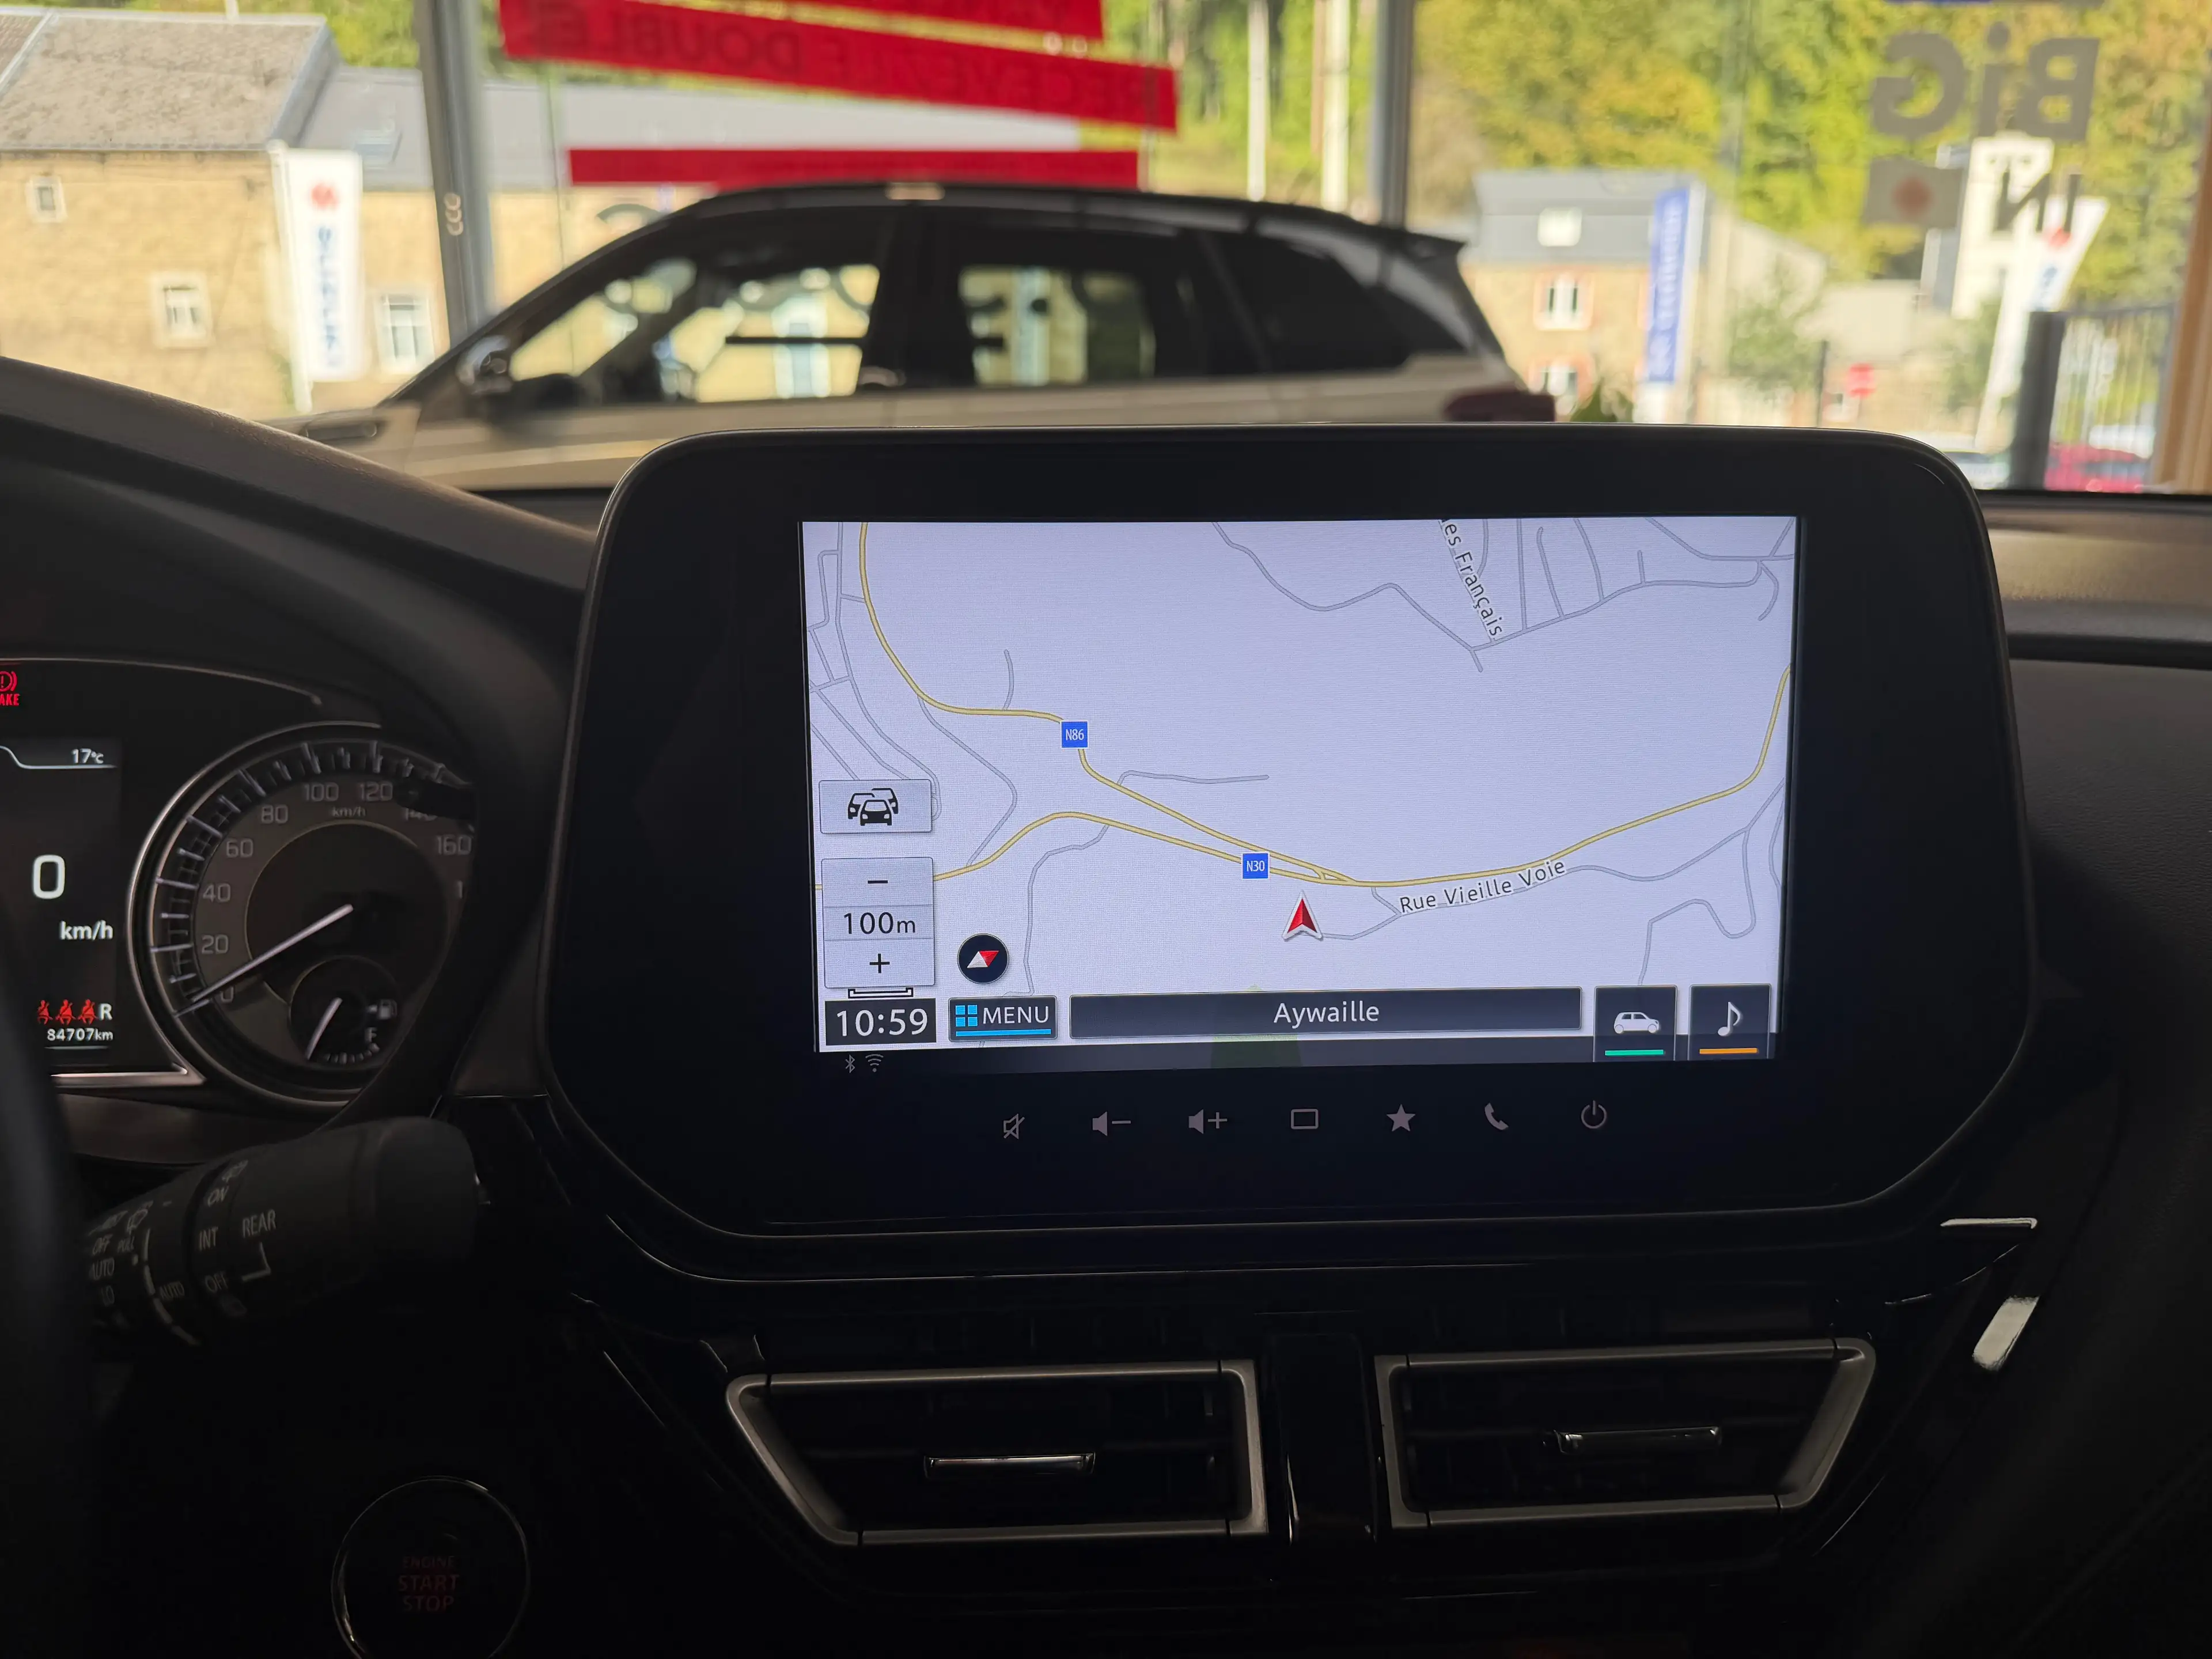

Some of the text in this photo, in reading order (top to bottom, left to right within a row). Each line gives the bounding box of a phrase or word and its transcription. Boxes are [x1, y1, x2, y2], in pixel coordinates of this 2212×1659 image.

[1442, 518, 1503, 637] es Français
[1065, 728, 1085, 742] N86
[304, 782, 339, 801] 100
[359, 782, 393, 801] 120
[261, 805, 288, 824] 80
[332, 806, 366, 817] km/h
[226, 839, 253, 858] 60
[436, 834, 472, 855] 160
[1245, 859, 1266, 873] N30
[33, 854, 65, 899] 0
[1399, 859, 1566, 913] Rue Vieille Voie
[203, 883, 230, 903] 40
[60, 920, 113, 940] km/h
[843, 912, 916, 935] 100m
[201, 934, 229, 954] 20
[836, 1008, 929, 1037] 10:59
[983, 1006, 1050, 1025] MENU
[1274, 1001, 1380, 1029] Aywaille
[47, 1028, 113, 1041] 84707km
[207, 1186, 229, 1207] ON
[241, 1209, 278, 1238] REAR
[198, 1226, 219, 1252] INT
[159, 1280, 185, 1301] AUTO
[204, 1271, 228, 1294] OFF
[402, 1555, 455, 1568] ENGINE
[399, 1574, 460, 1591] START
[403, 1595, 454, 1611] STOP
